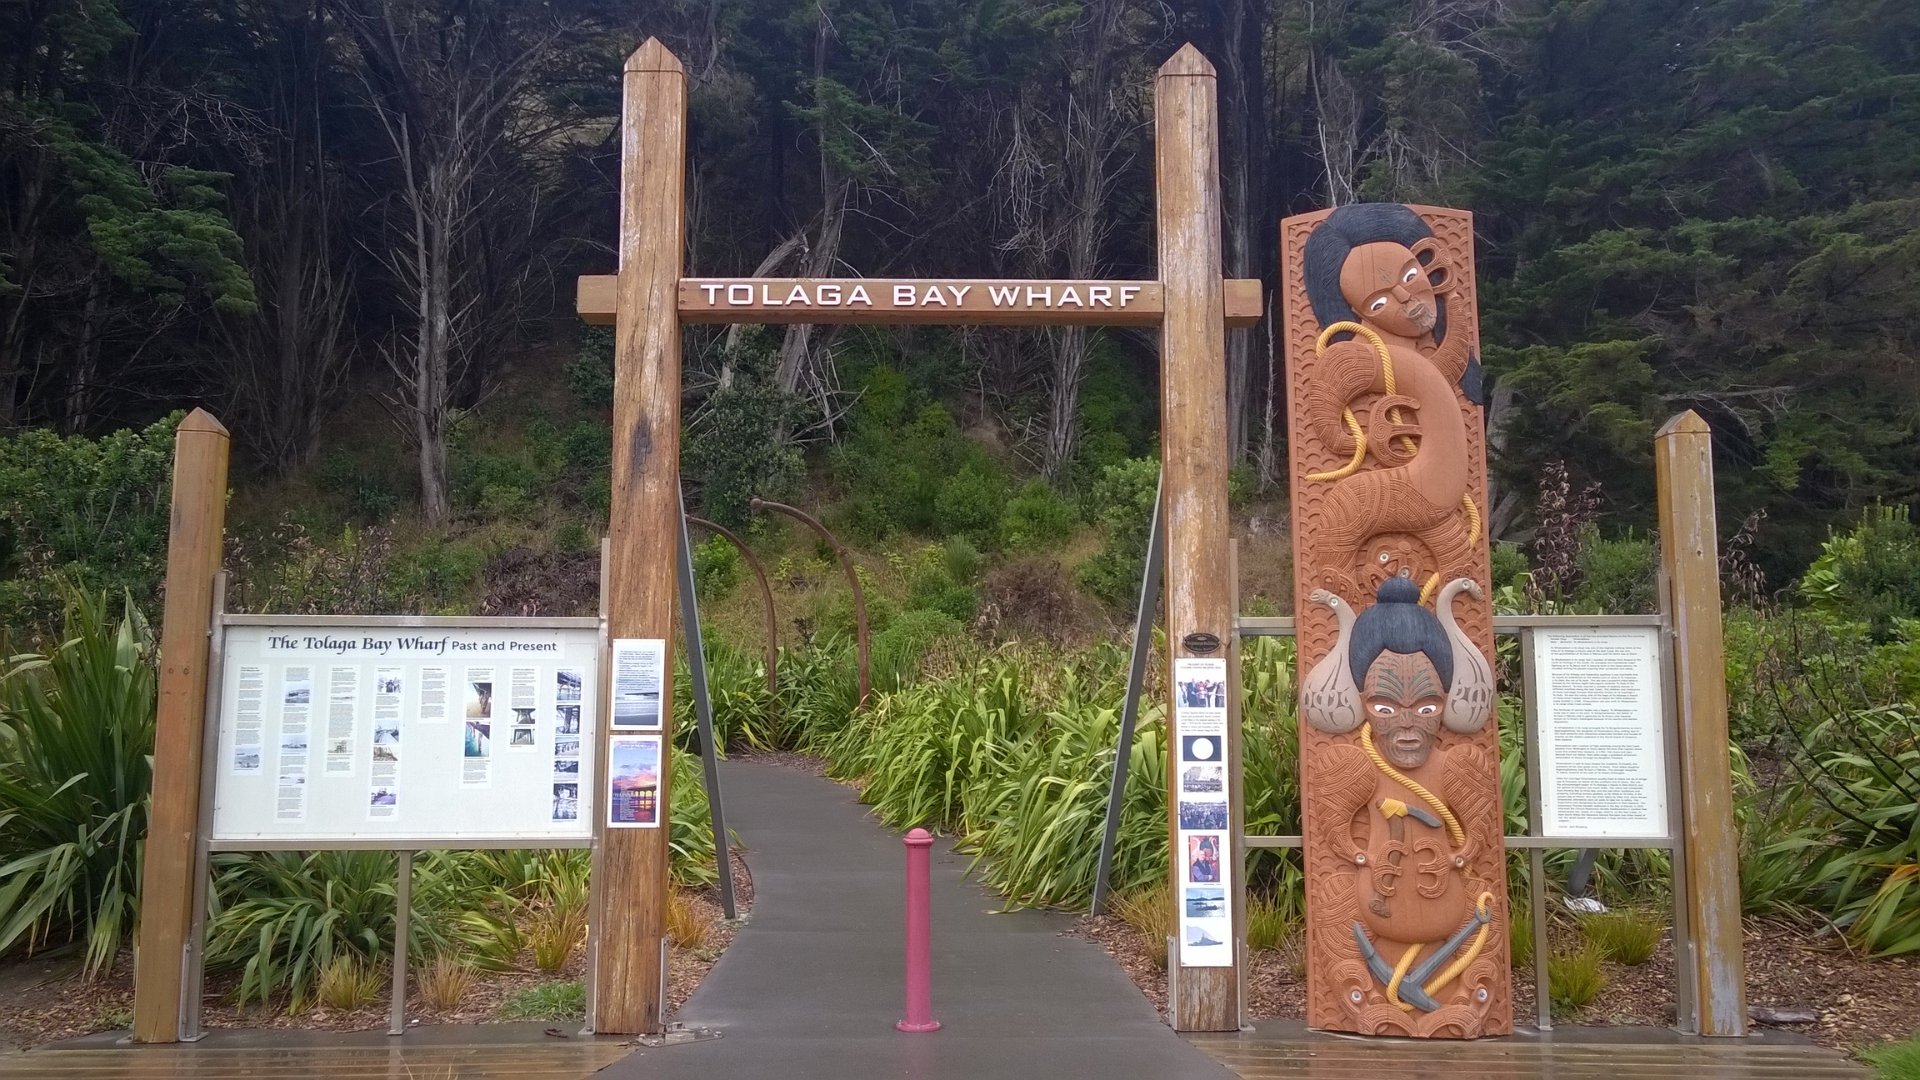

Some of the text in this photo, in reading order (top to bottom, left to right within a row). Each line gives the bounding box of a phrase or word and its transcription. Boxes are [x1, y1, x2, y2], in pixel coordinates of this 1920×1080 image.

[700, 285, 1141, 307] TOLAGA BAY WHARF
[268, 636, 558, 655] The Tolaga Bay Wharf Past and Present
